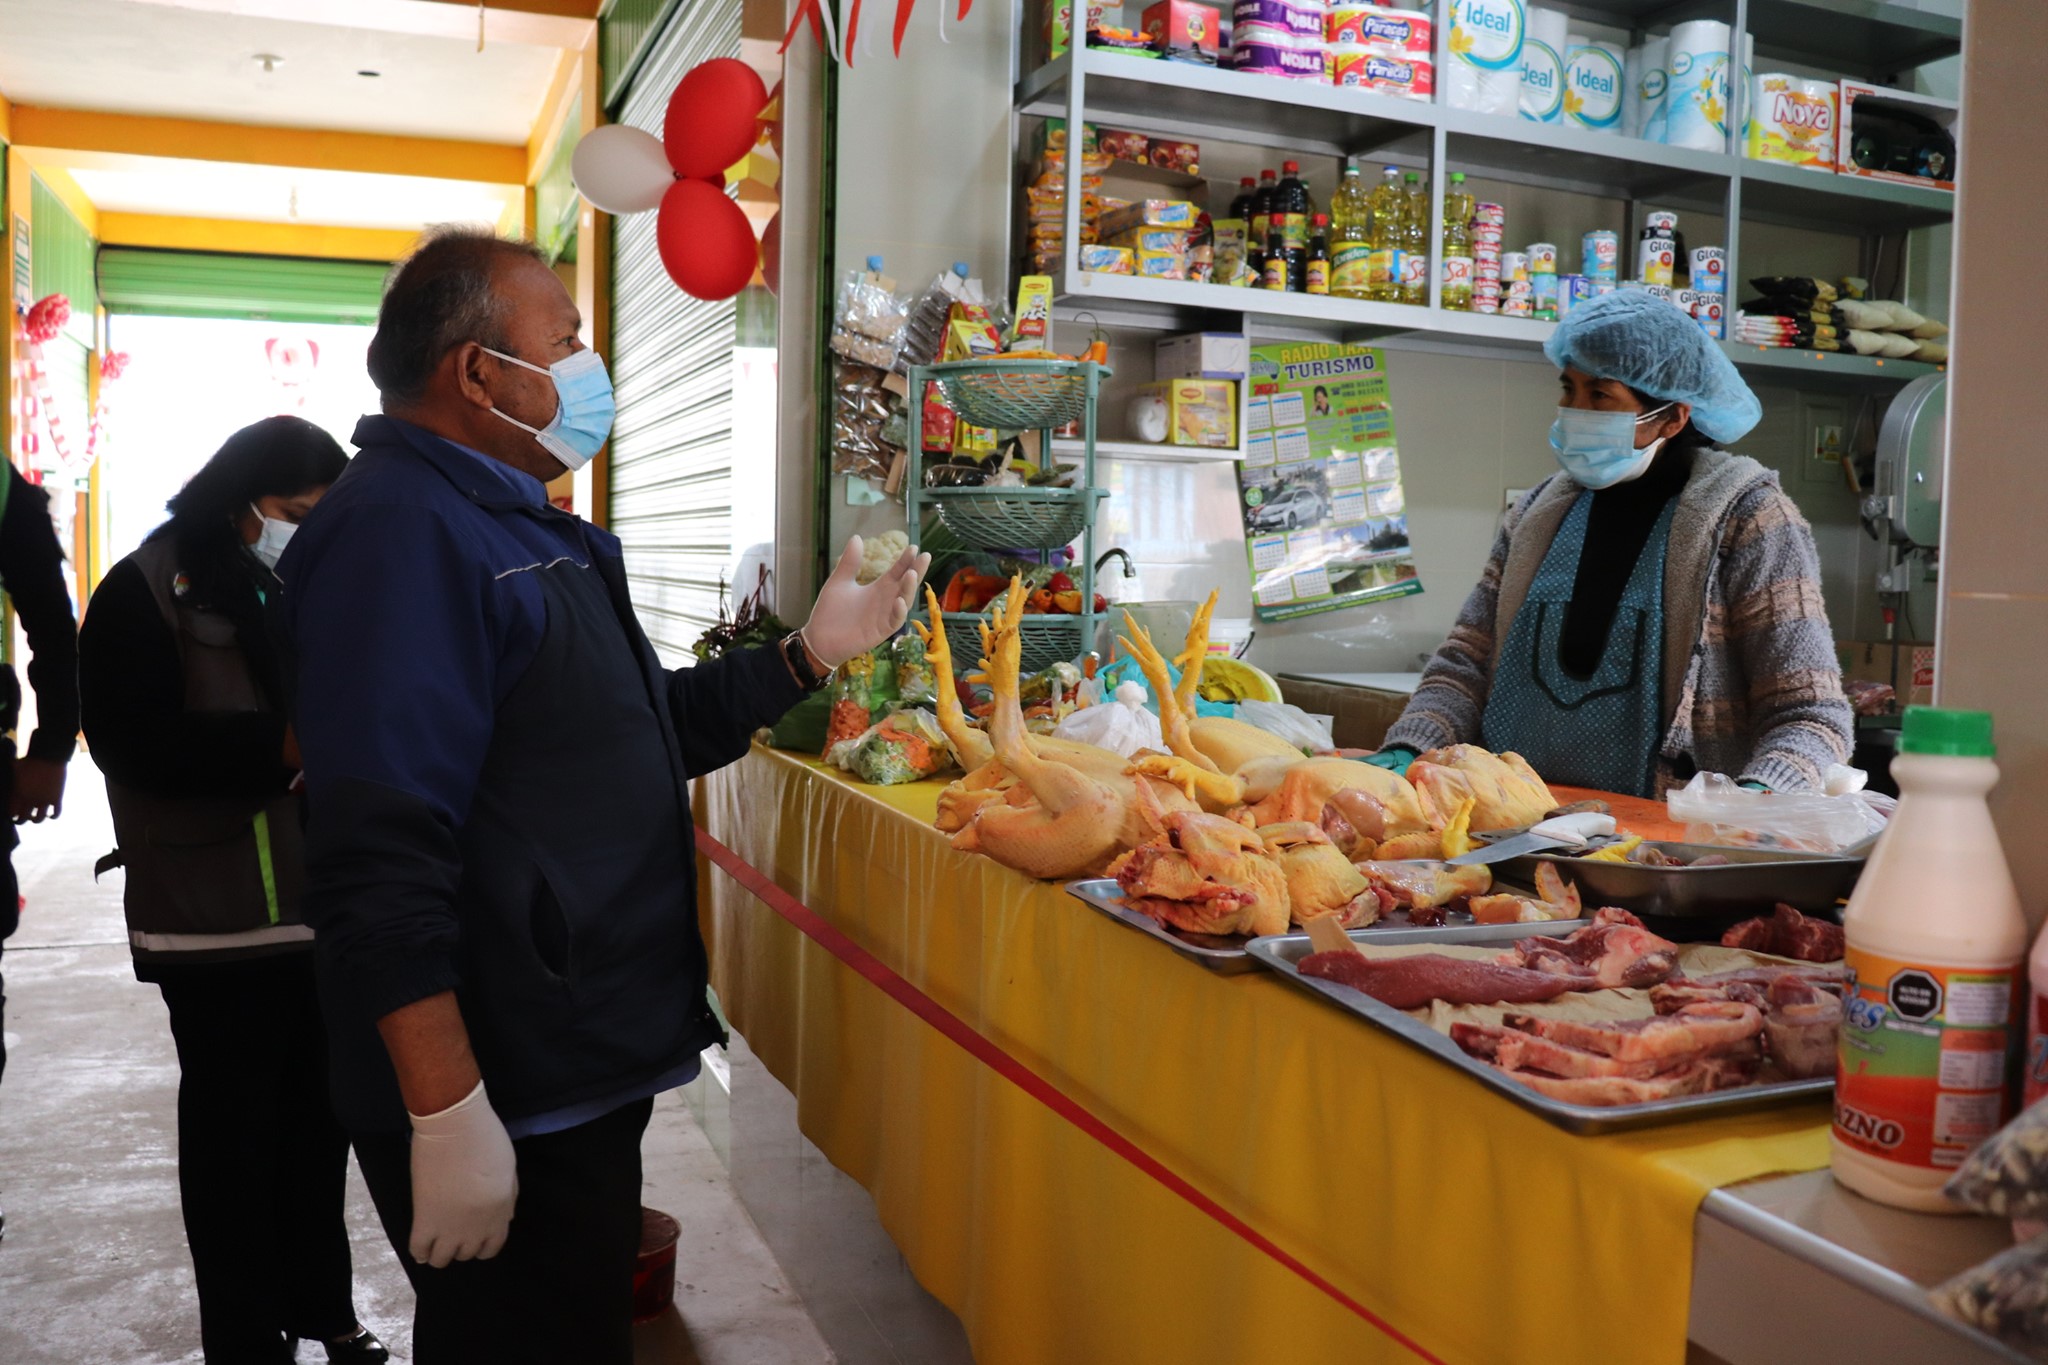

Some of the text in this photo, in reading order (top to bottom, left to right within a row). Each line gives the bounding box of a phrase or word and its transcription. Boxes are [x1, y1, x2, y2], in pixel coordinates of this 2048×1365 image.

[1364, 17, 1409, 37] Paracas
[1466, 2, 1511, 33] Ideal
[1280, 51, 1321, 71] NOBLE
[1368, 60, 1410, 80] Paracas
[1576, 66, 1613, 93] Ideal
[1773, 94, 1831, 130] Nova
[1281, 343, 1329, 363] RADIO
[1285, 355, 1374, 379] TURISMO
